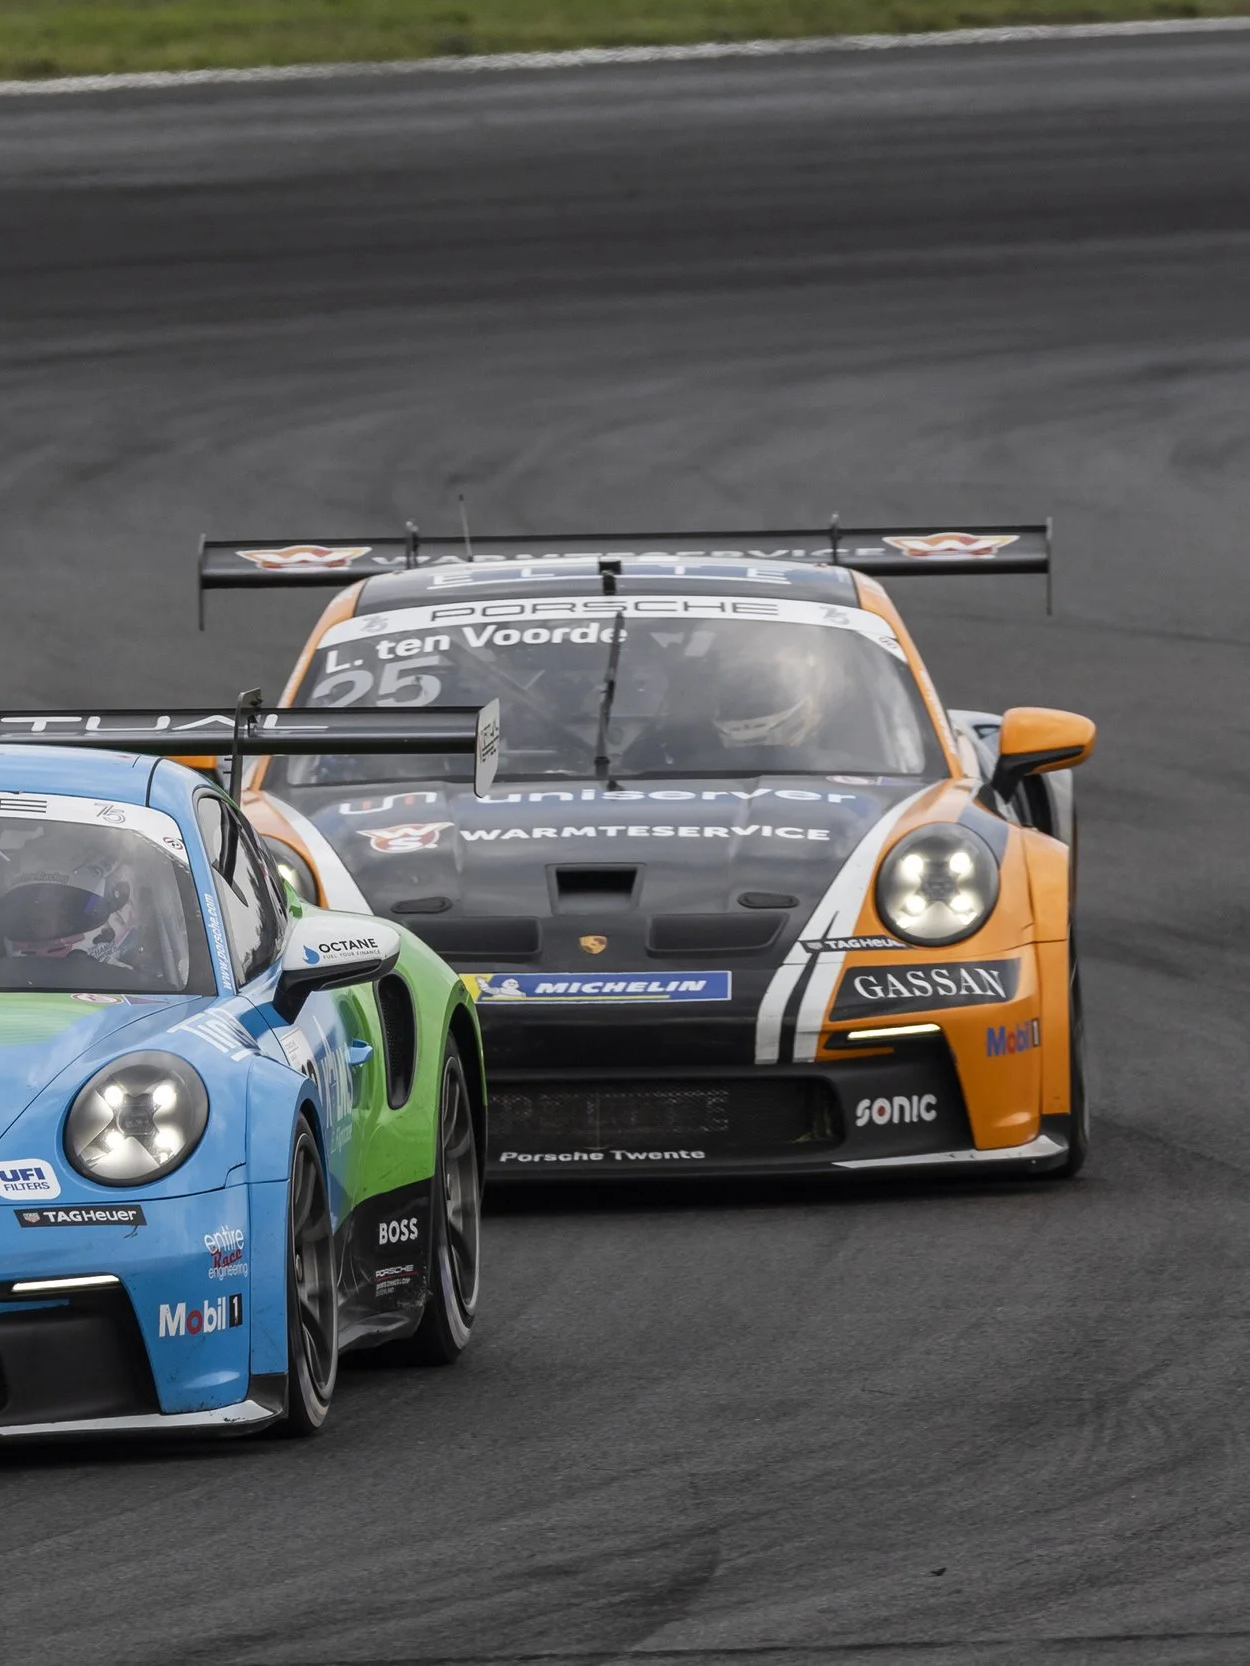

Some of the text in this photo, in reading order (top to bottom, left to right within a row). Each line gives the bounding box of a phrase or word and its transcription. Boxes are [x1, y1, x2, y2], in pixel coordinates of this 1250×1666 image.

[432, 563, 788, 586] ELTE
[430, 600, 779, 622] PORSCHE
[325, 623, 628, 674] L. ten Voorde
[311, 655, 442, 707] 25
[475, 788, 857, 804] uniserver
[459, 825, 831, 841] WARMTESERVICE
[318, 938, 379, 954] OCTANE
[534, 980, 707, 994] MICHELIN
[853, 968, 1007, 1000] GASSAN
[499, 1149, 706, 1162] Porsche Twente
[3, 1181, 51, 1192] FILTERS
[203, 1224, 245, 1254] entire
[378, 1217, 419, 1245] BOSS
[211, 1248, 244, 1269] Race
[208, 1262, 249, 1280] engineering
[158, 1296, 226, 1337] Mobil
